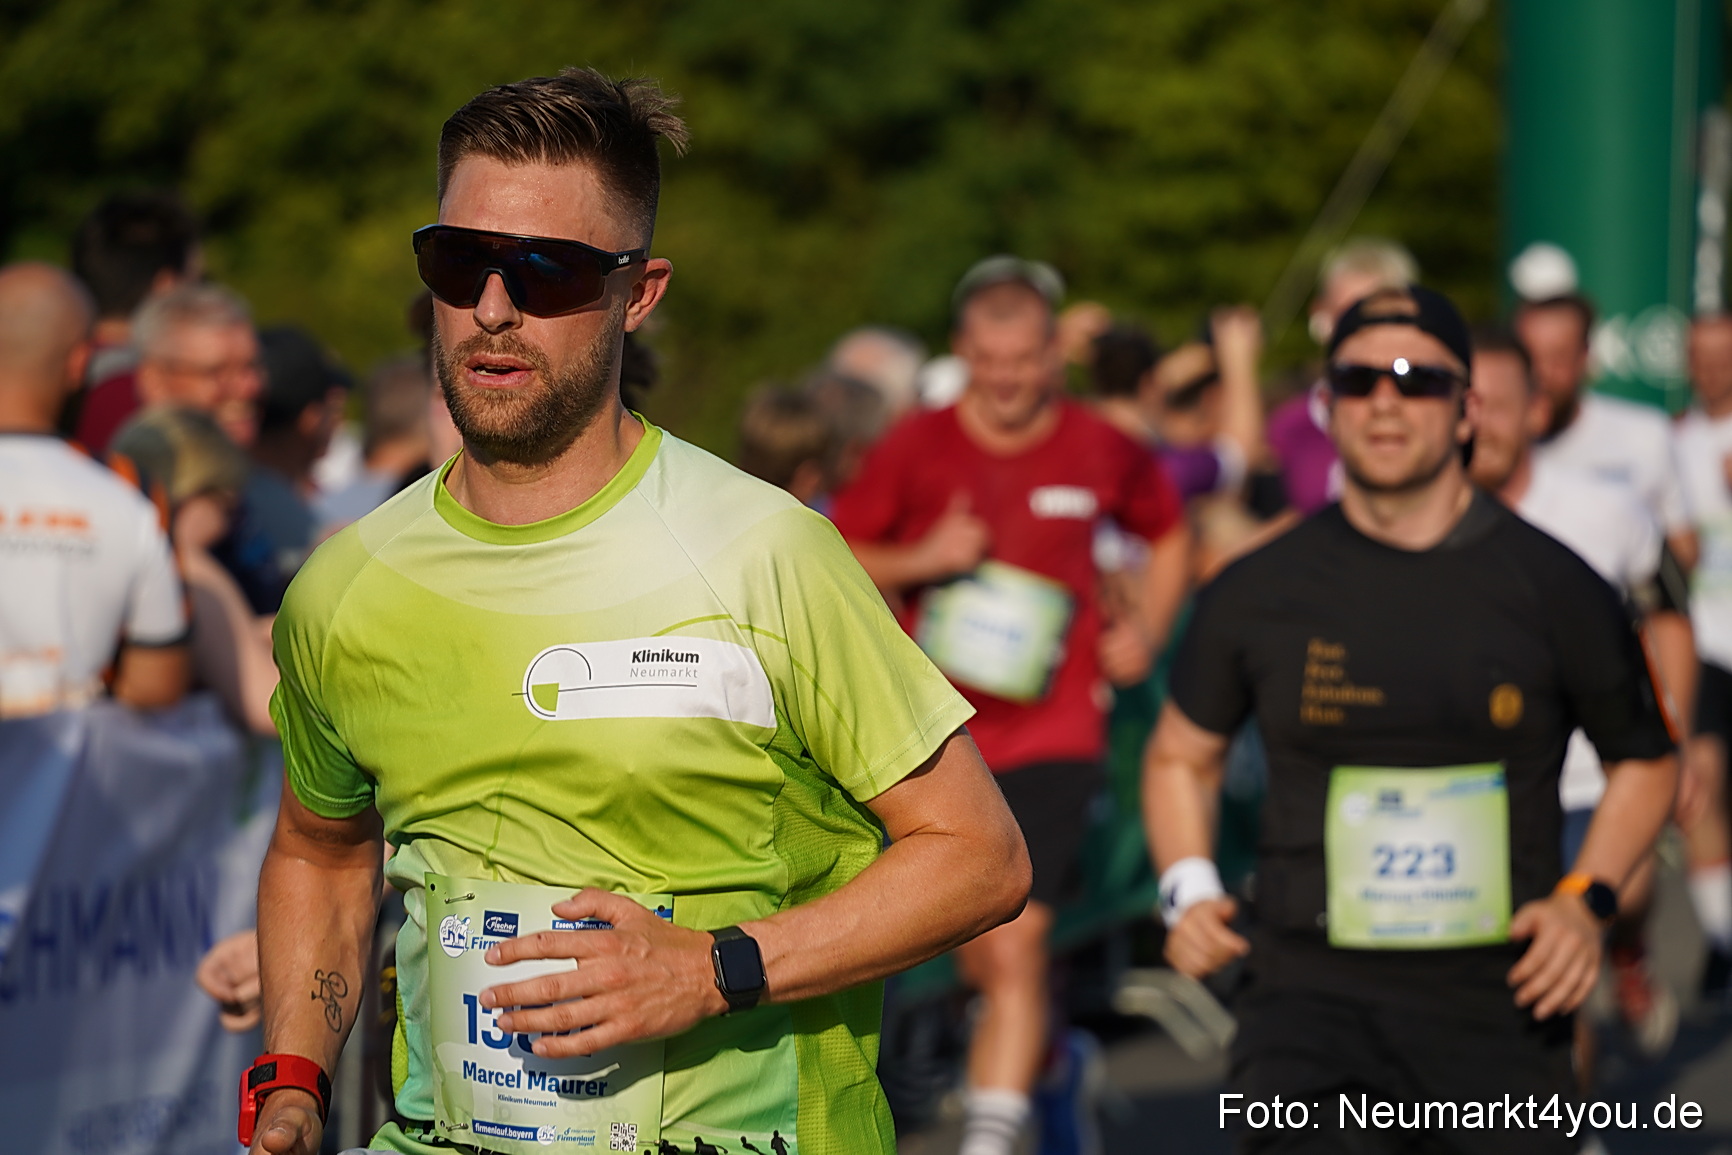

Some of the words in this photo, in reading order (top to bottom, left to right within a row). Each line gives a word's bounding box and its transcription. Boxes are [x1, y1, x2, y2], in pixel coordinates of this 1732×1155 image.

[631, 649, 700, 664] Klinikum
[629, 667, 698, 679] Neumarkt
[1372, 844, 1455, 879] 223
[462, 1060, 522, 1089] Marcel
[527, 1070, 609, 1097] Maurer
[497, 1093, 523, 1104] Klinikum
[523, 1097, 557, 1108] Neumarkt
[475, 1122, 534, 1140] firmenlauf.bayern
